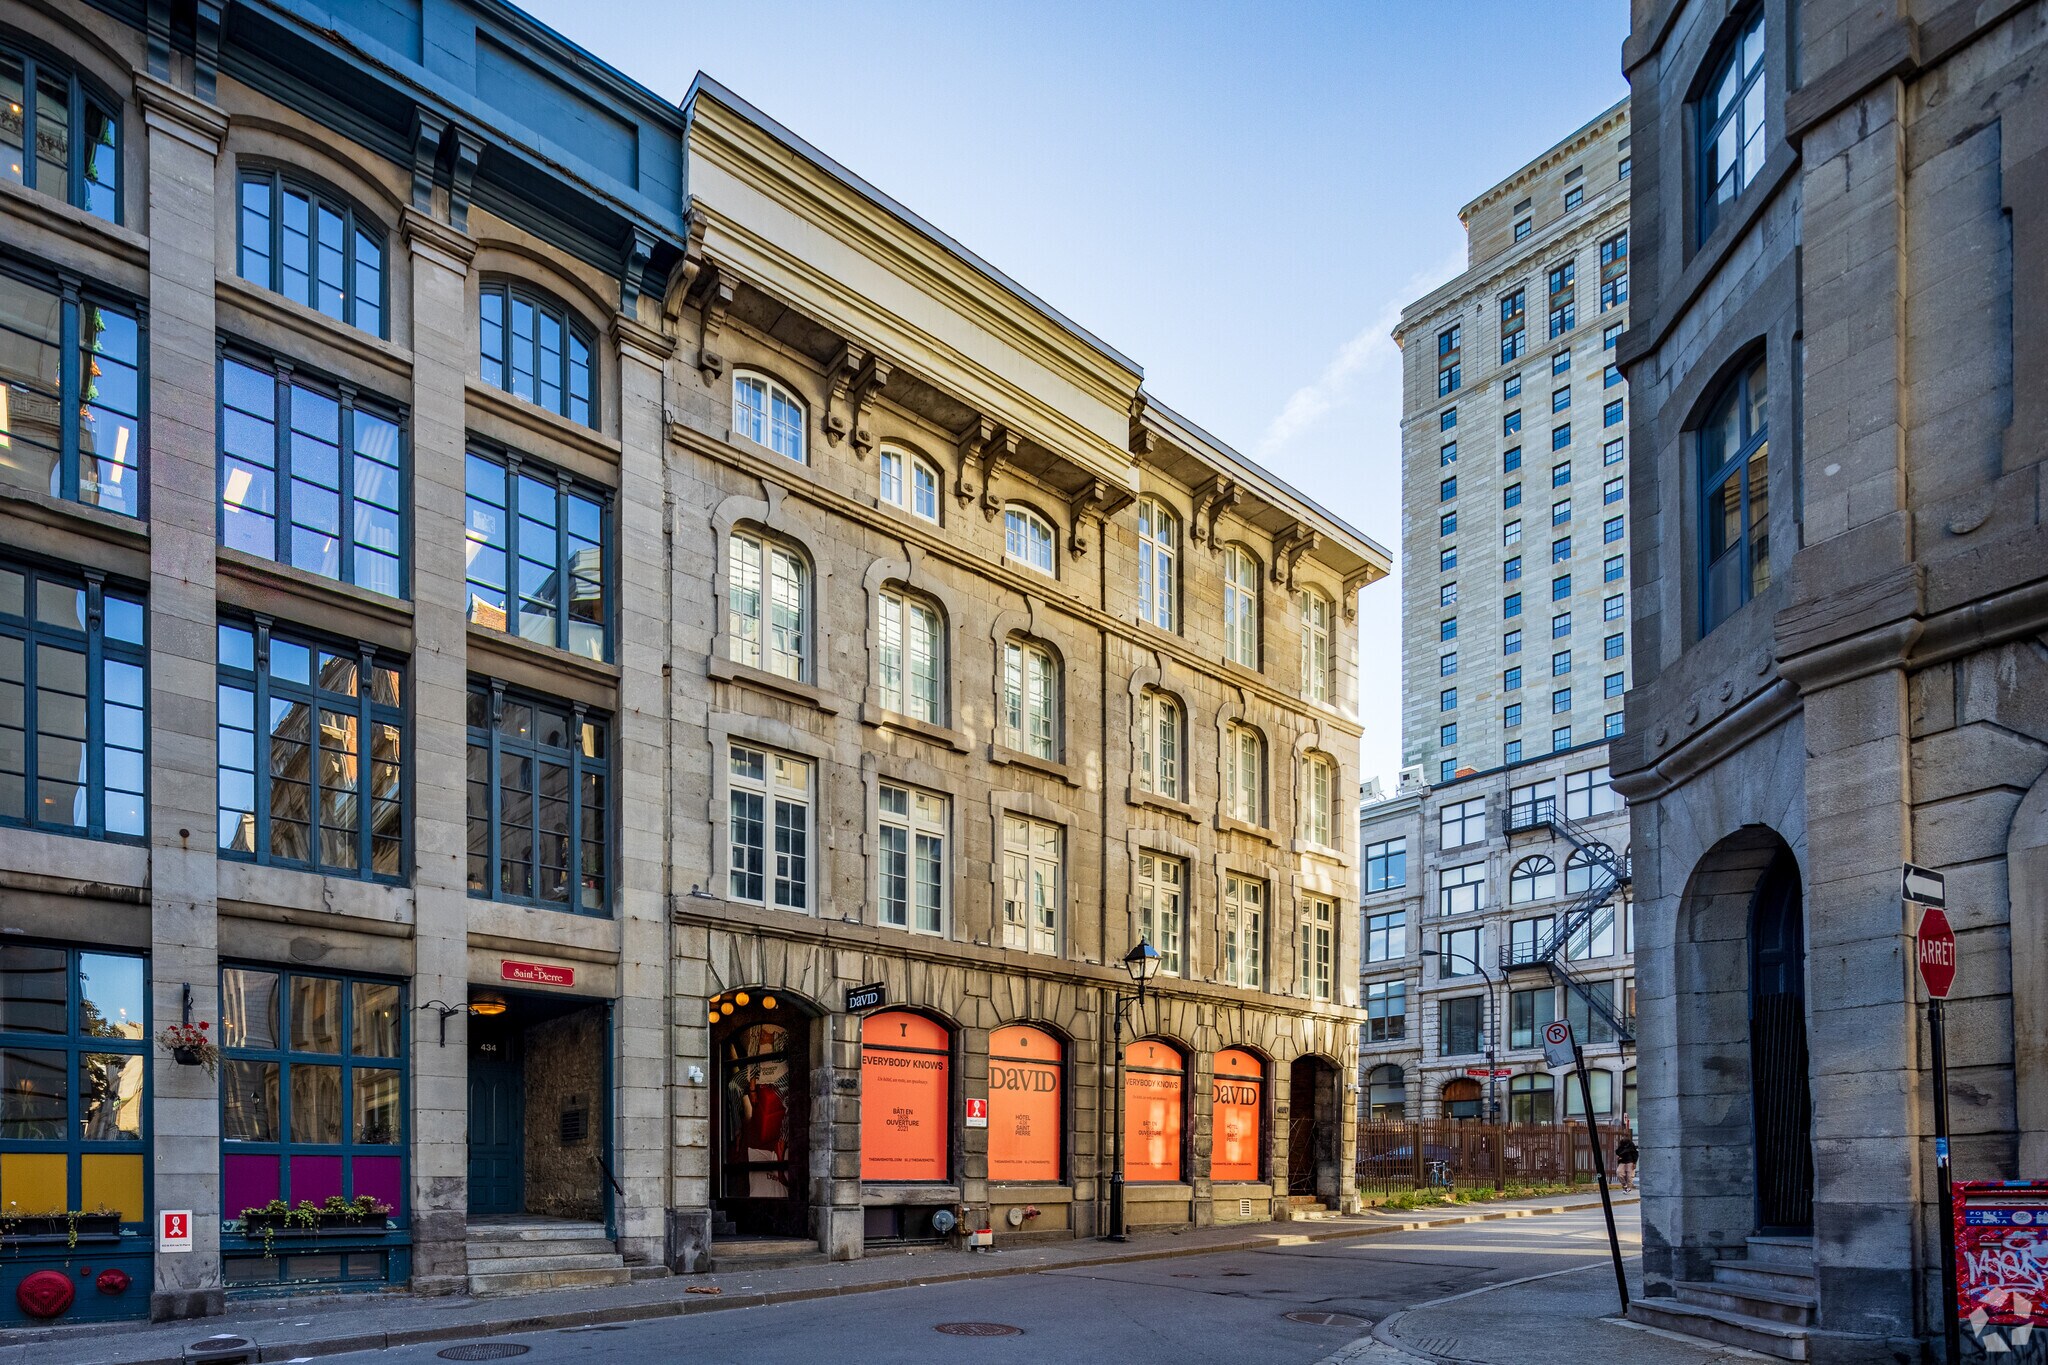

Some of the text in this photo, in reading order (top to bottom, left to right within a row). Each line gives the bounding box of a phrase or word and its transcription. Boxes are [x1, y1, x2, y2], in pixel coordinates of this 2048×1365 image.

[1920, 937, 1954, 966] ARRÊT
[513, 968, 563, 982] Saint-Pierre
[480, 1043, 496, 1051] 434
[862, 1056, 943, 1070] EVERYBODY KNOWS
[1125, 1078, 1178, 1089] VERYBODY KNOWS
[892, 1106, 905, 1115] BÂTI
[1015, 1113, 1031, 1121] HÔTEL
[886, 1119, 920, 1127] OUVERTURE
